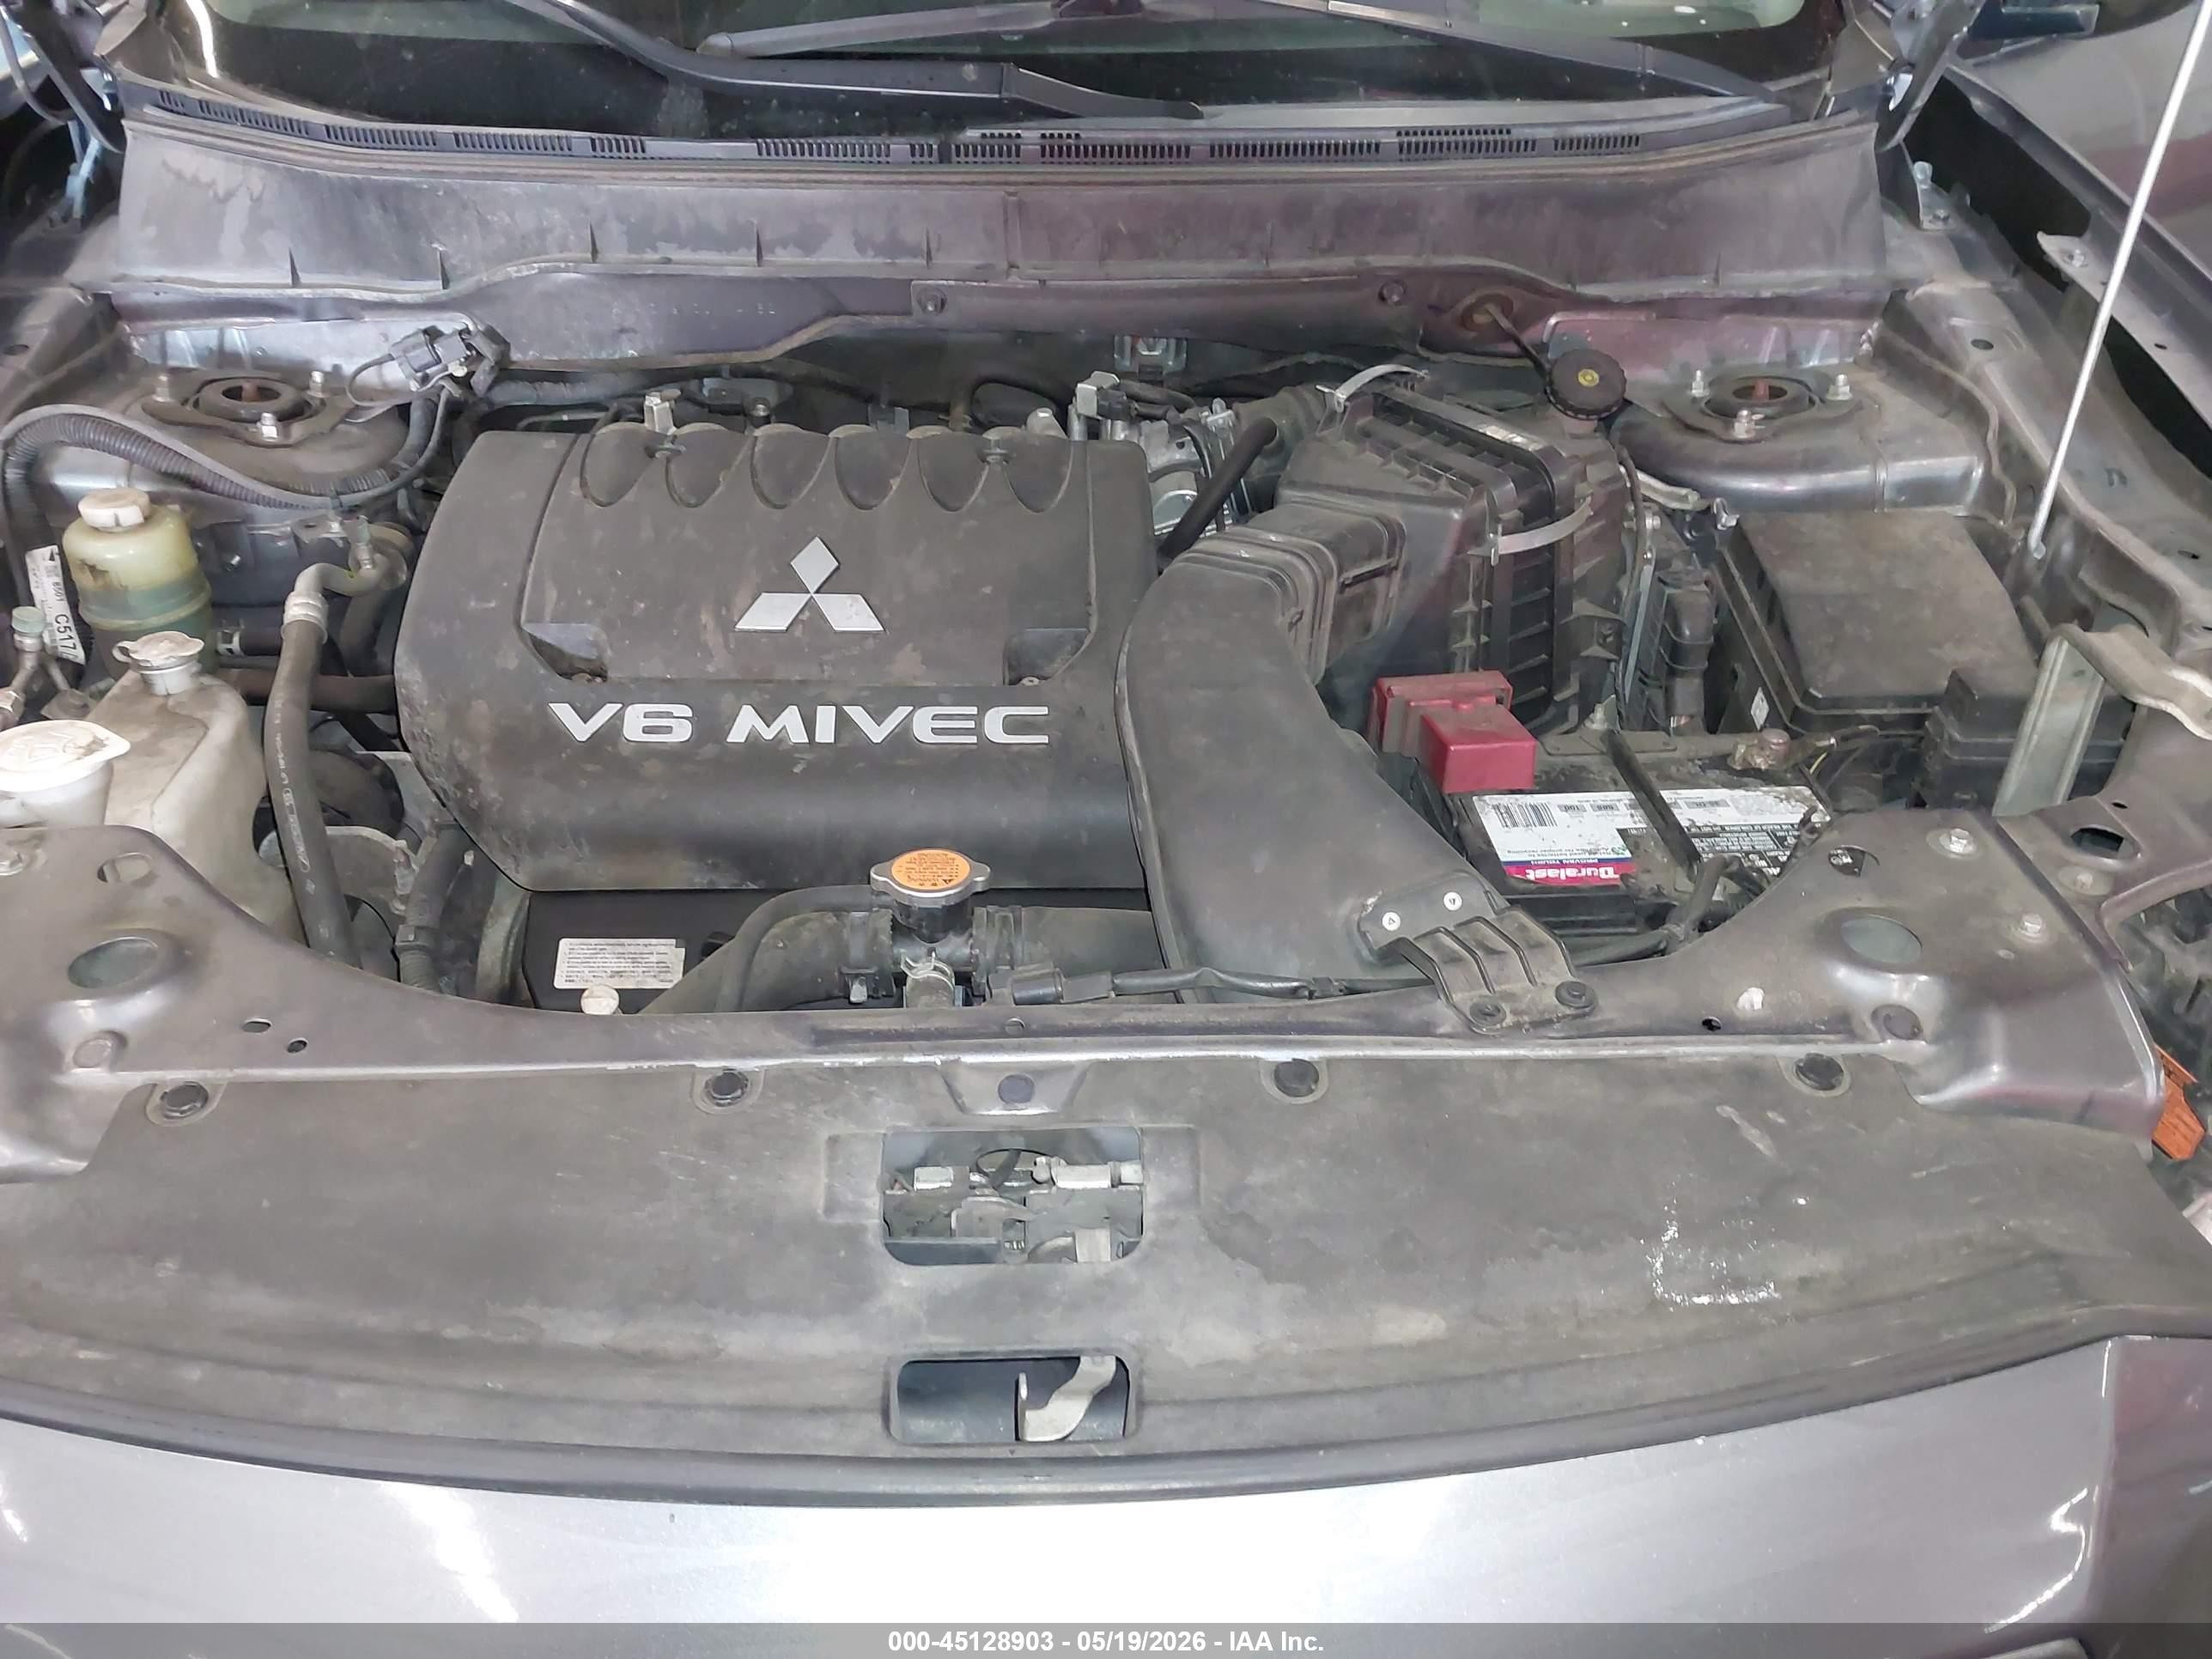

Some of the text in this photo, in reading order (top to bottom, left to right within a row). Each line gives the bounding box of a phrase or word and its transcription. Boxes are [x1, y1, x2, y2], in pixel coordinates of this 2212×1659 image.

[548, 702, 1049, 744] V6 MIVEC
[1525, 866, 1620, 881] Duralast
